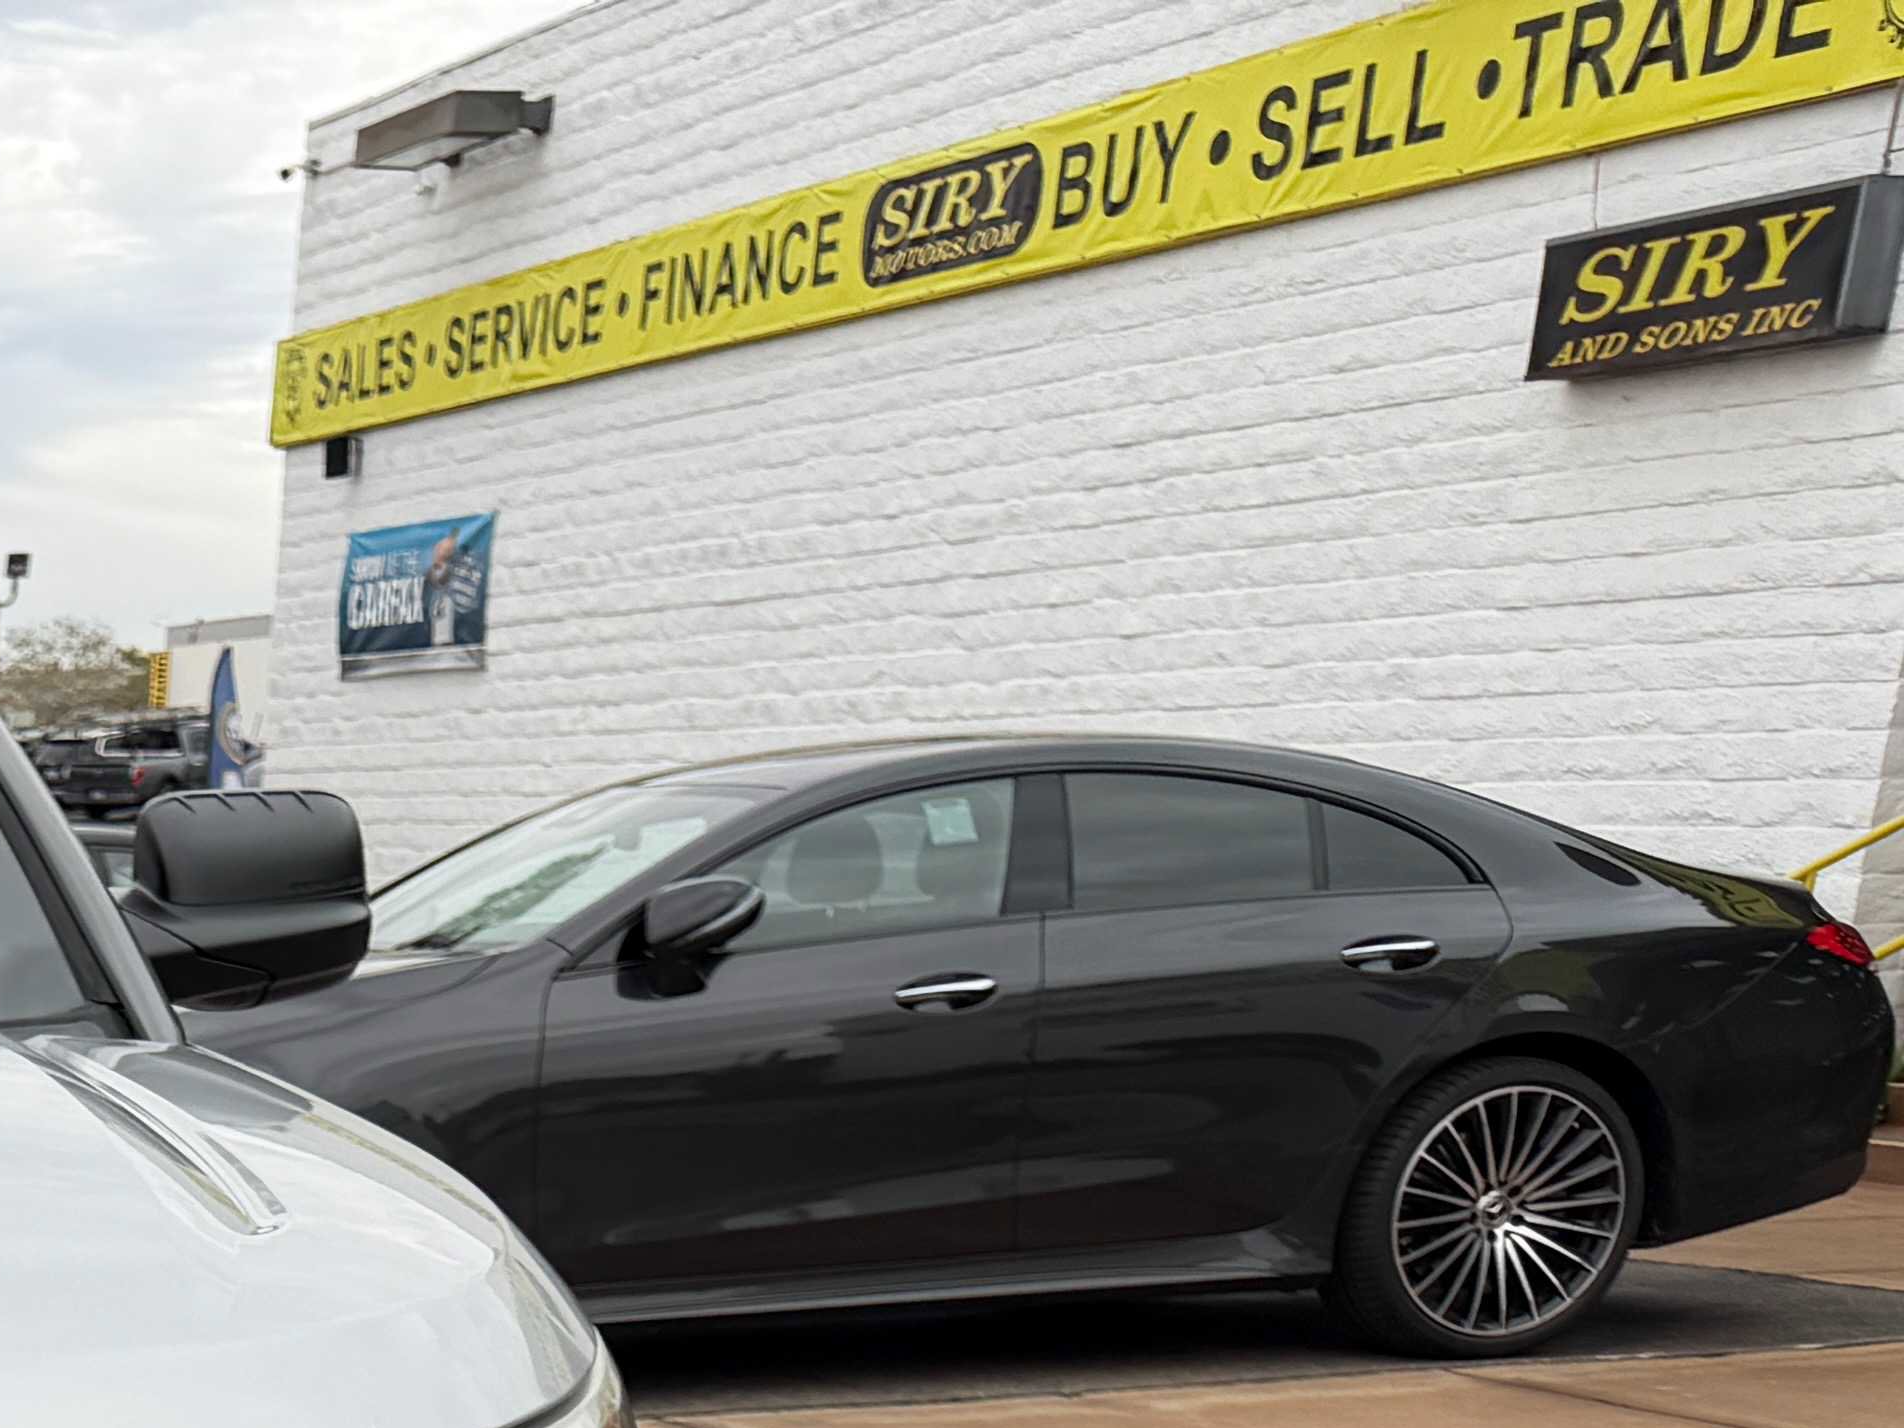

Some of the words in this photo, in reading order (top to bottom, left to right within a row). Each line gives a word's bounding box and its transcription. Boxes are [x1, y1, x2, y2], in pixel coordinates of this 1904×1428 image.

[1051, 110, 1197, 230] BUY
[1250, 50, 1447, 182] SELL
[1513, 0, 1832, 119] TRADE
[869, 221, 1024, 279] MOTORS.COM
[872, 153, 1033, 250] SIRY
[313, 330, 418, 411] SALES
[444, 279, 604, 380] SERVICE
[639, 212, 841, 329] FINANCE
[1560, 206, 1838, 326] SIRY
[1546, 333, 1628, 369] AND
[1633, 312, 1738, 355] SONS
[1742, 298, 1823, 336] INC
[347, 576, 425, 630] CARFAX
